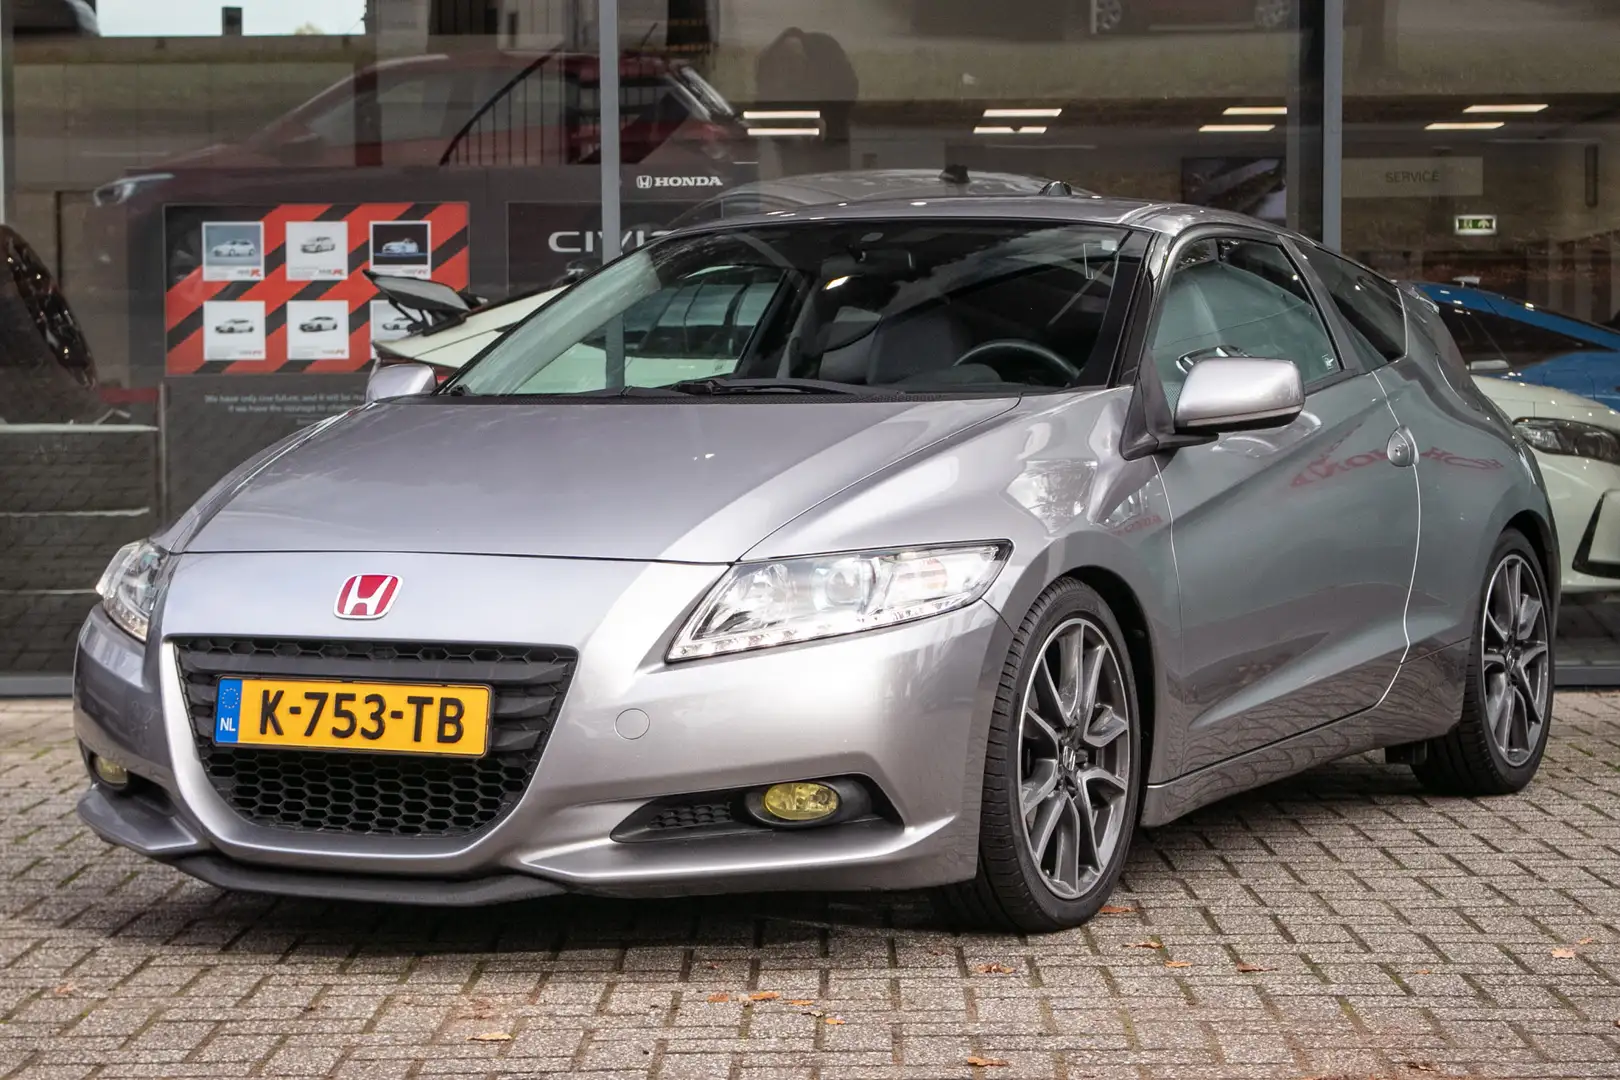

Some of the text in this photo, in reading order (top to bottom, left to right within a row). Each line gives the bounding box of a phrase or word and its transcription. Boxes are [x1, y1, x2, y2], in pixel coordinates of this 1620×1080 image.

[654, 176, 723, 187] HONDA
[1385, 170, 1440, 183] SERVICE
[259, 689, 465, 744] K-753-TB
[219, 717, 236, 732] NL
